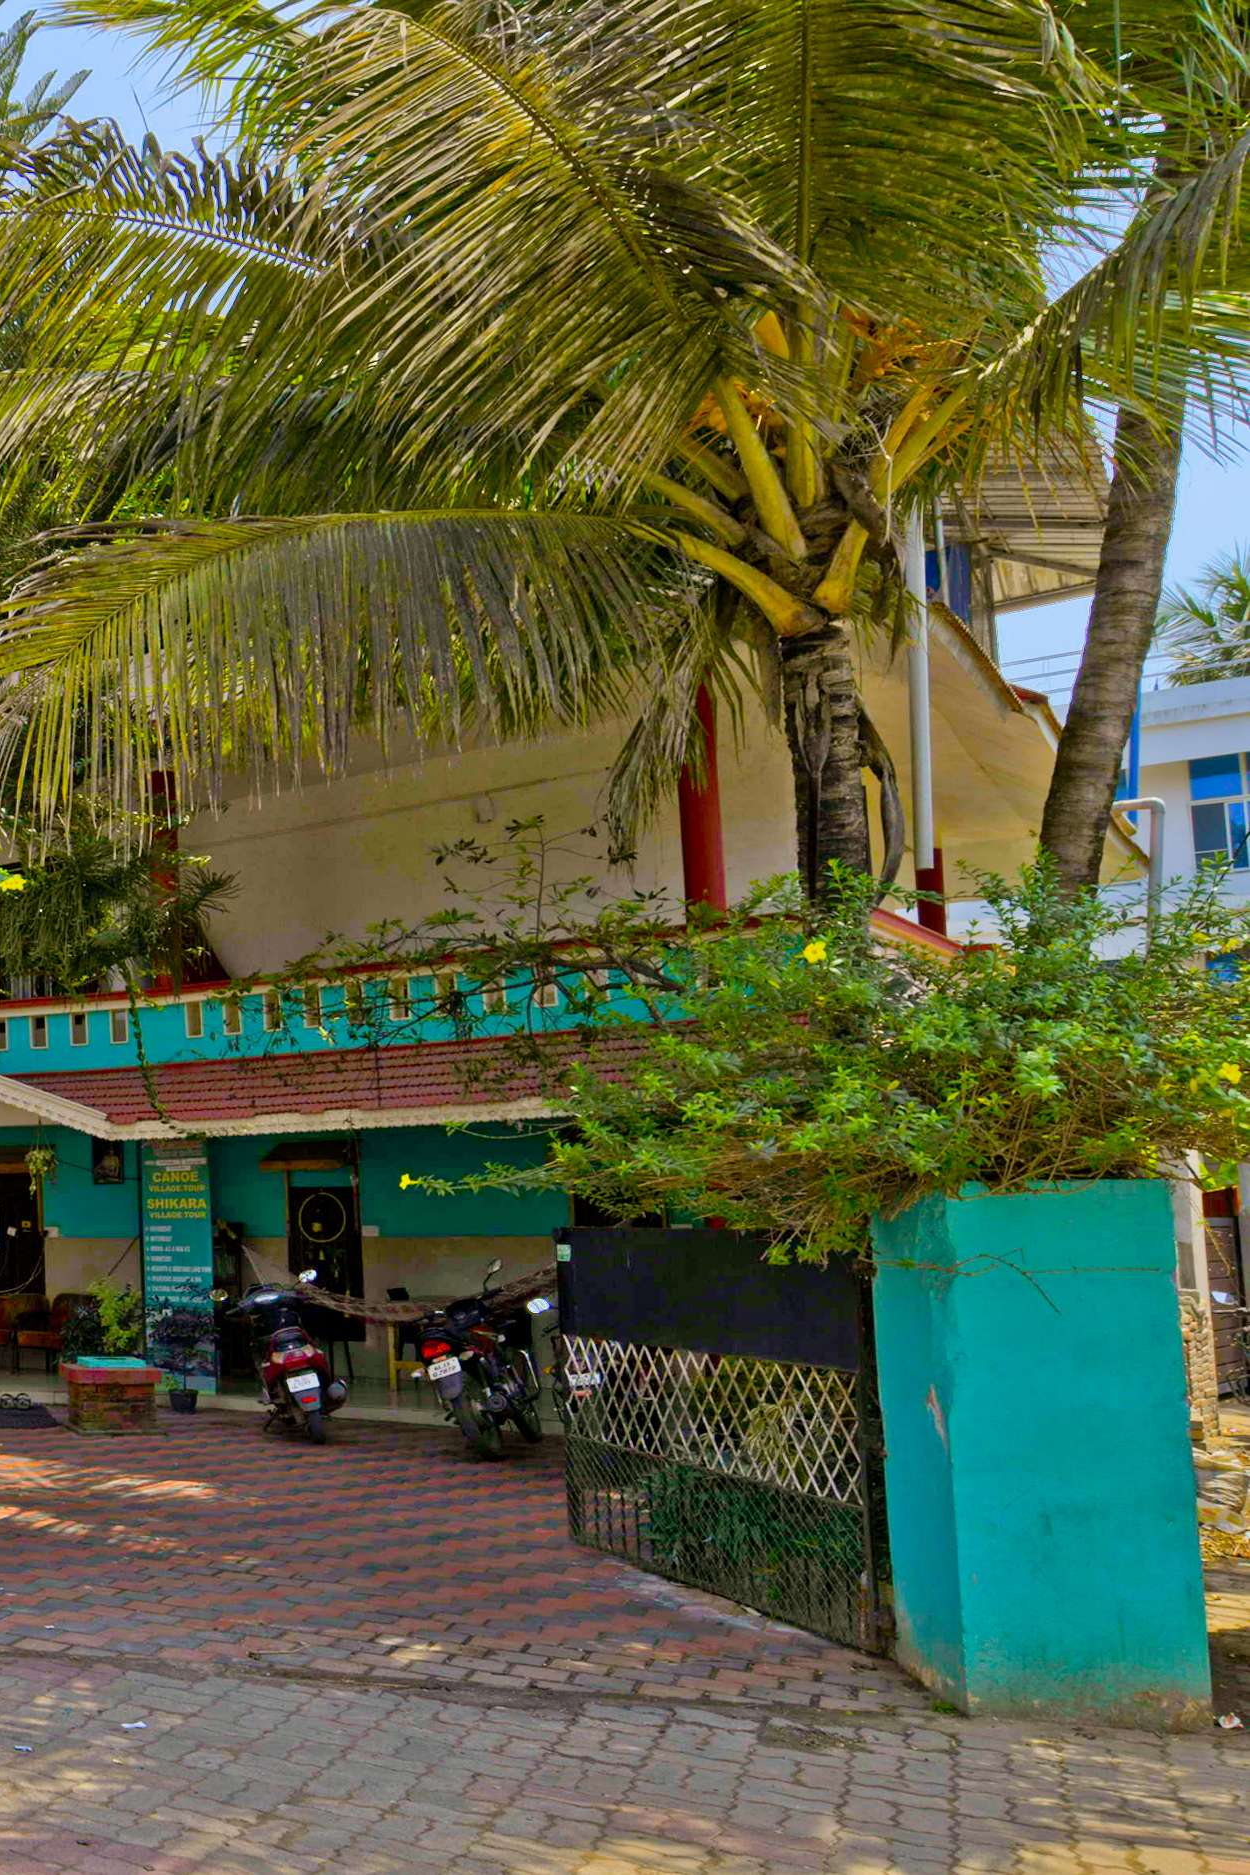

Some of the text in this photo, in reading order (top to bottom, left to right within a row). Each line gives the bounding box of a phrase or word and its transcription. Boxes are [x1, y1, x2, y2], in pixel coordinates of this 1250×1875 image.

[152, 1171, 199, 1183] CANOE
[149, 1184, 182, 1193] VILLAGE
[147, 1198, 207, 1209] SHIKARA
[150, 1211, 182, 1220] VILLAGE
